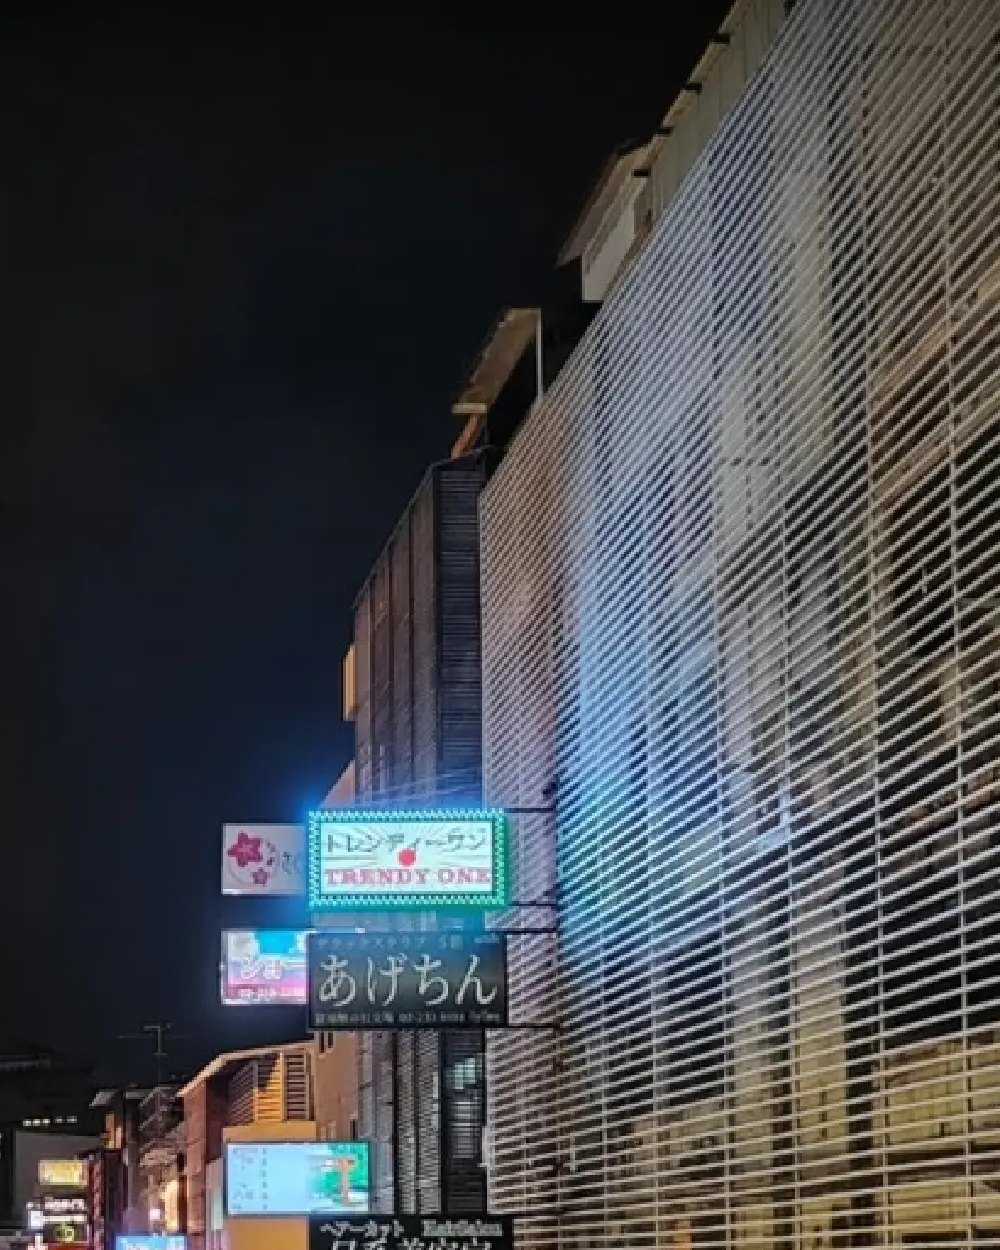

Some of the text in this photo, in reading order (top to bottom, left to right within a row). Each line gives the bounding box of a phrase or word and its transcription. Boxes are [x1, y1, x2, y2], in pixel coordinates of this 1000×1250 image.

[325, 868, 492, 885] TRENDY ONE
[319, 953, 498, 1007] あげちん
